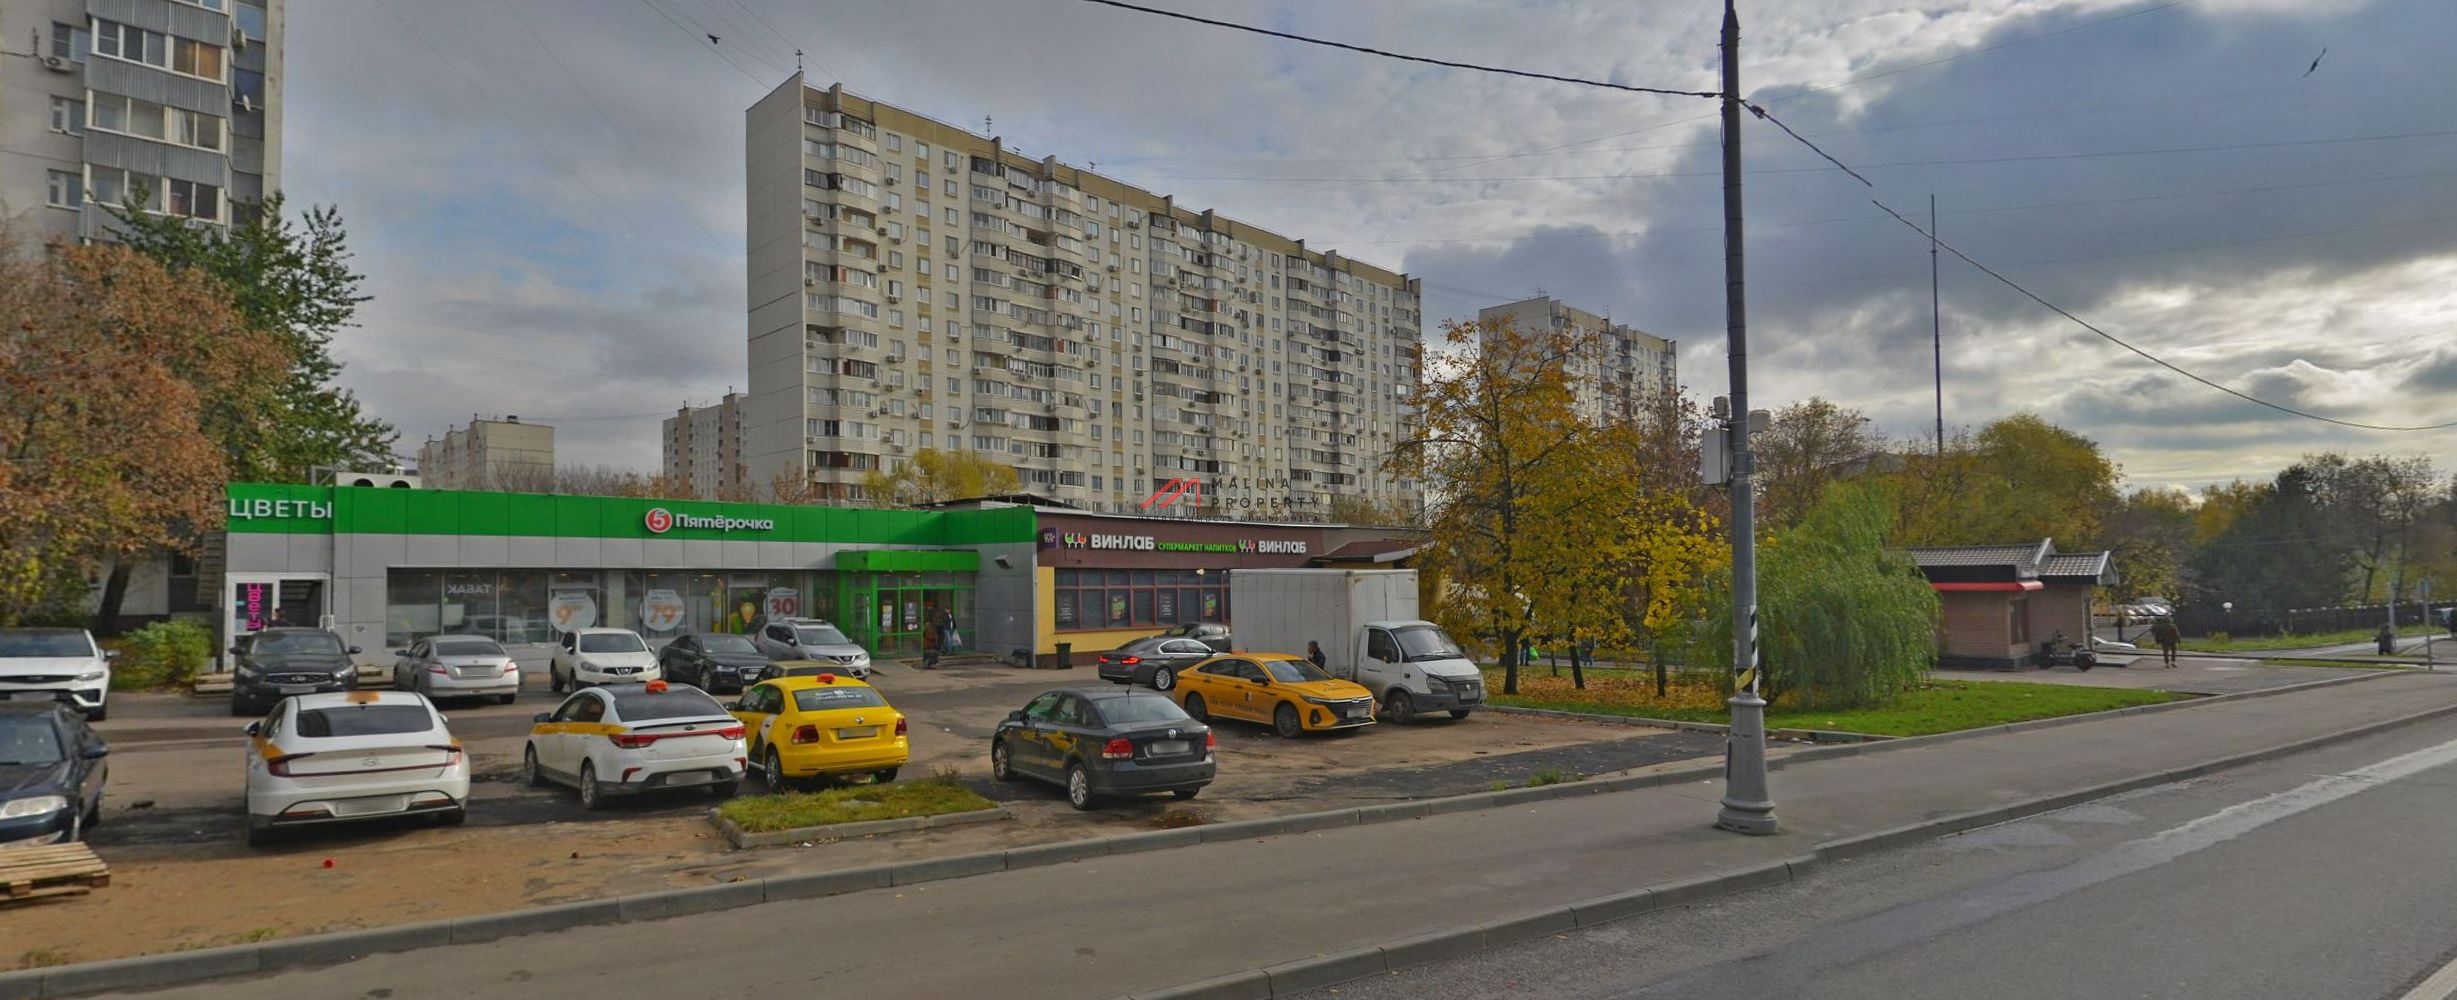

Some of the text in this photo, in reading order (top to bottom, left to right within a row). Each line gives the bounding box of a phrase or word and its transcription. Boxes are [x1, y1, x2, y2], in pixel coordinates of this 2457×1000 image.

[229, 498, 332, 520] ЦВЕТЫ
[675, 513, 774, 532] Пятёрочка
[1158, 542, 1237, 553] СУПЕРМАРКЕТ НАПИТКОВ
